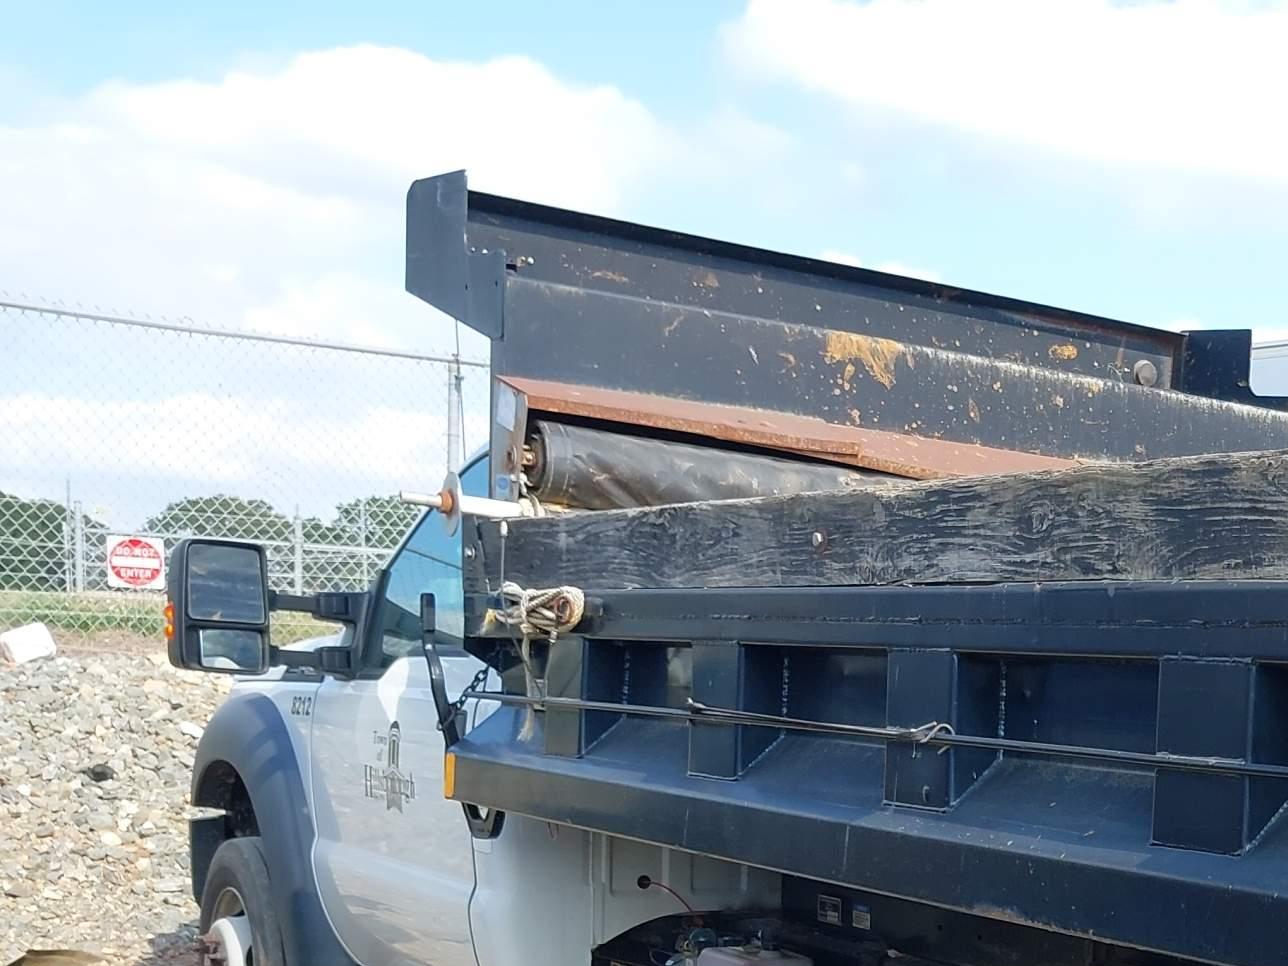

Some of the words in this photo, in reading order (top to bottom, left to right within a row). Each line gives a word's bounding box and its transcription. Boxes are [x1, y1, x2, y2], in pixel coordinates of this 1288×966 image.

[115, 546, 130, 556] DO
[132, 547, 156, 557] NOT
[120, 567, 152, 579] ENTER
[291, 696, 312, 716] 8212
